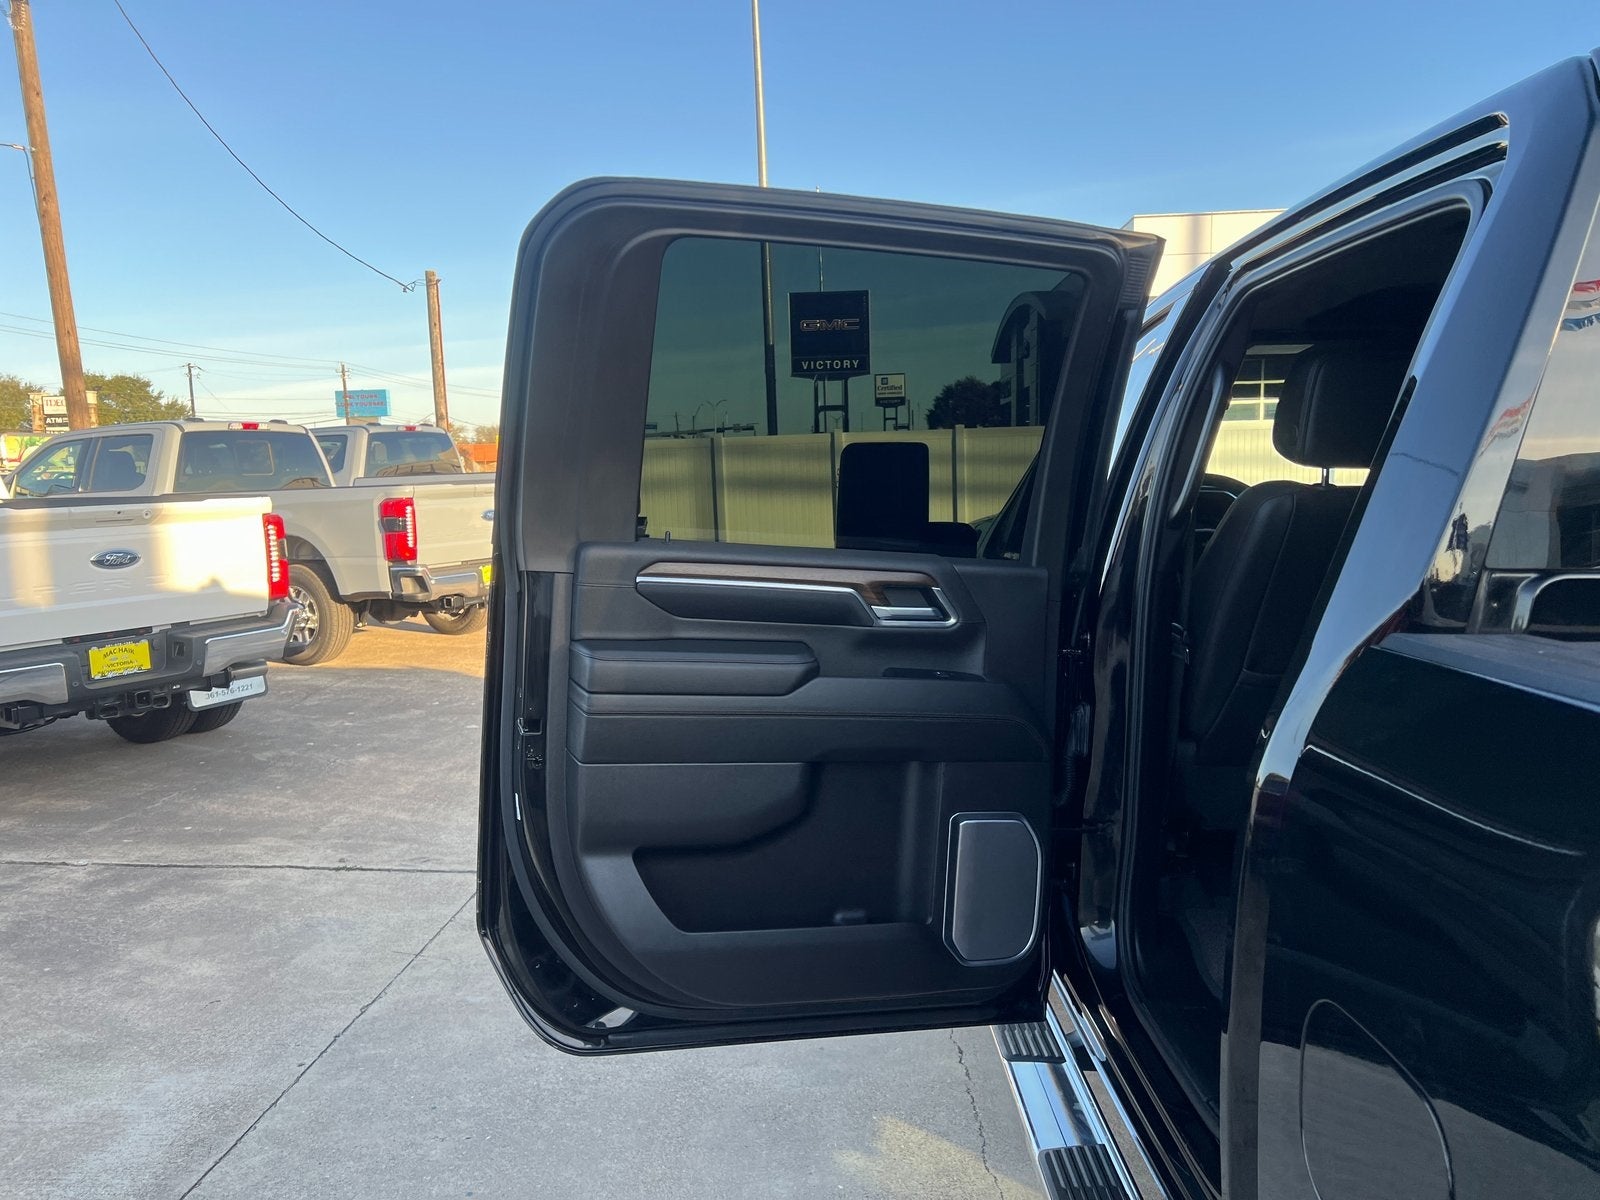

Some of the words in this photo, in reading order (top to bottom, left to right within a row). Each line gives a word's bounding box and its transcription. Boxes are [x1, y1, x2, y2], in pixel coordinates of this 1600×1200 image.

[800, 318, 860, 332] GMC
[802, 360, 859, 370] VICTORY
[104, 553, 131, 565] Ford
[103, 648, 117, 659] MAC
